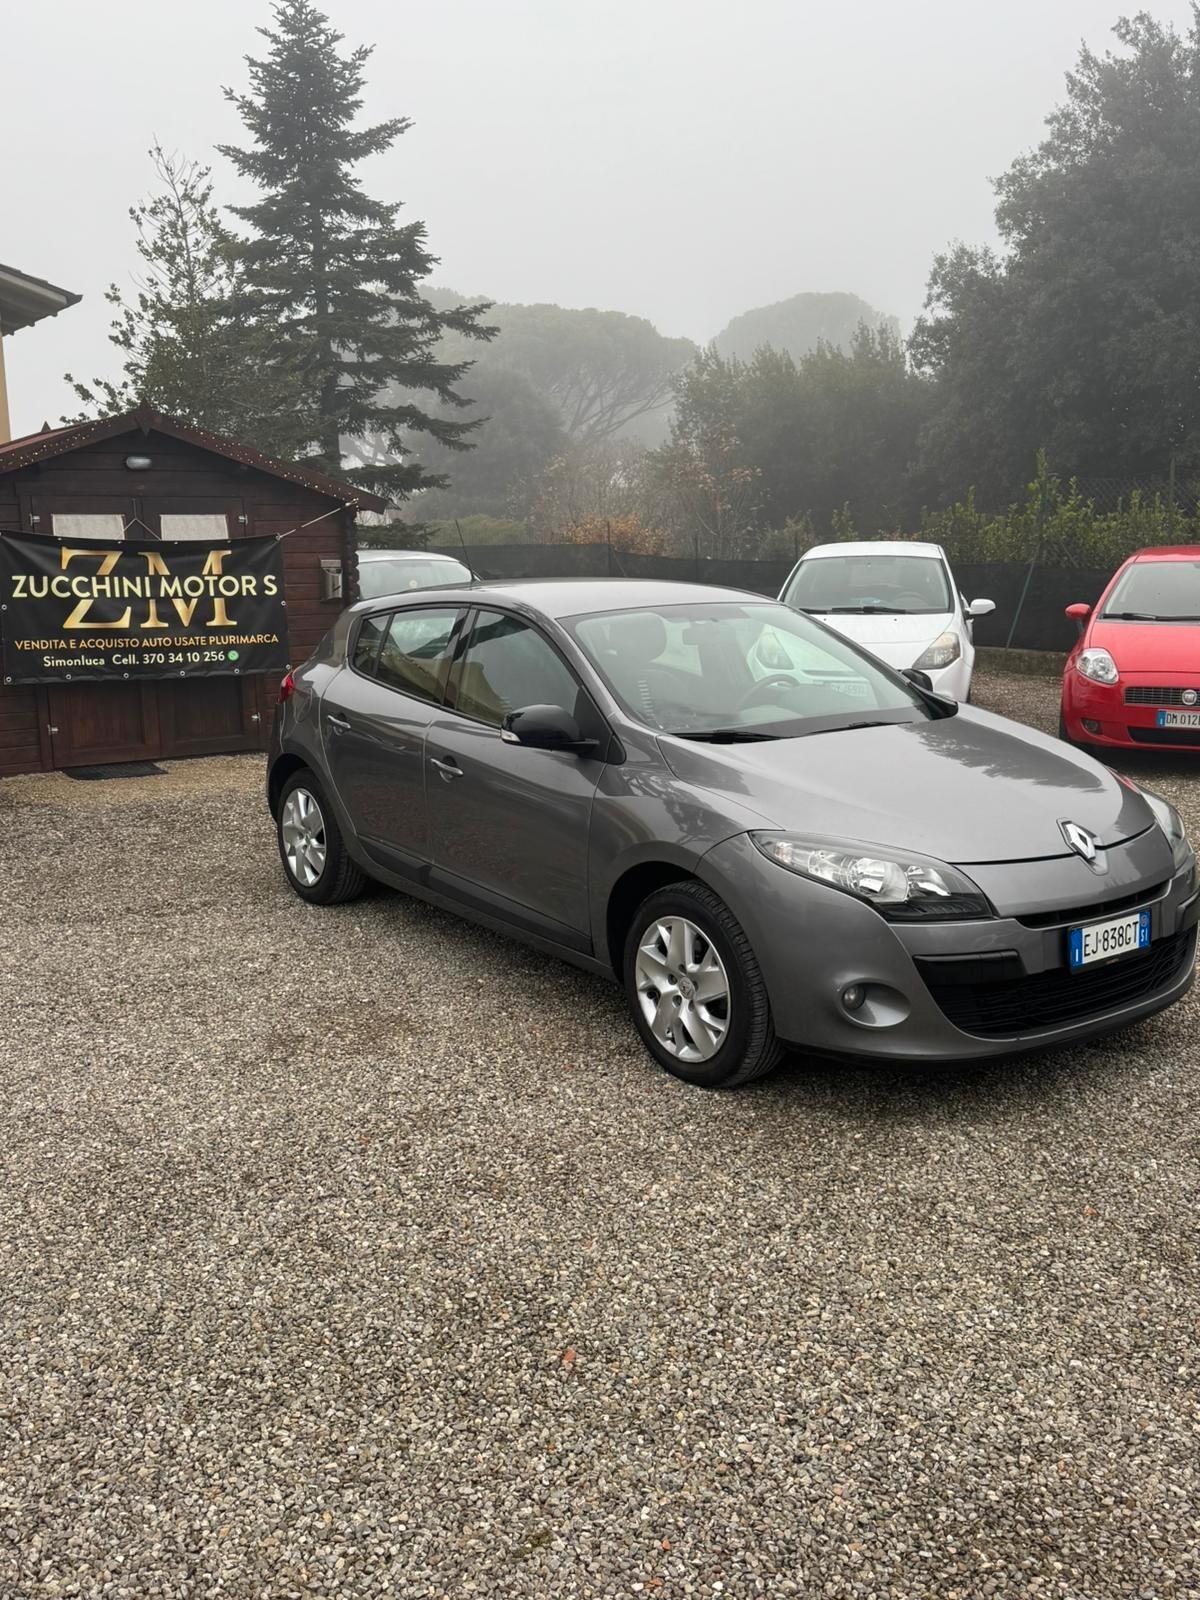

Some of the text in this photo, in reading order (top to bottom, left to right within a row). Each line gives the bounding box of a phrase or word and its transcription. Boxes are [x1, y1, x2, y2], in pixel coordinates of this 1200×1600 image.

[11, 575, 151, 598] ZUCCHINI
[61, 547, 237, 629] ZM
[15, 634, 279, 651] VENDITA E ACQUISTO AUTO USATE PLURIMARCA
[43, 651, 225, 668] Simonluca Cell. 370 34 10 256
[1180, 714, 1200, 726] 012
